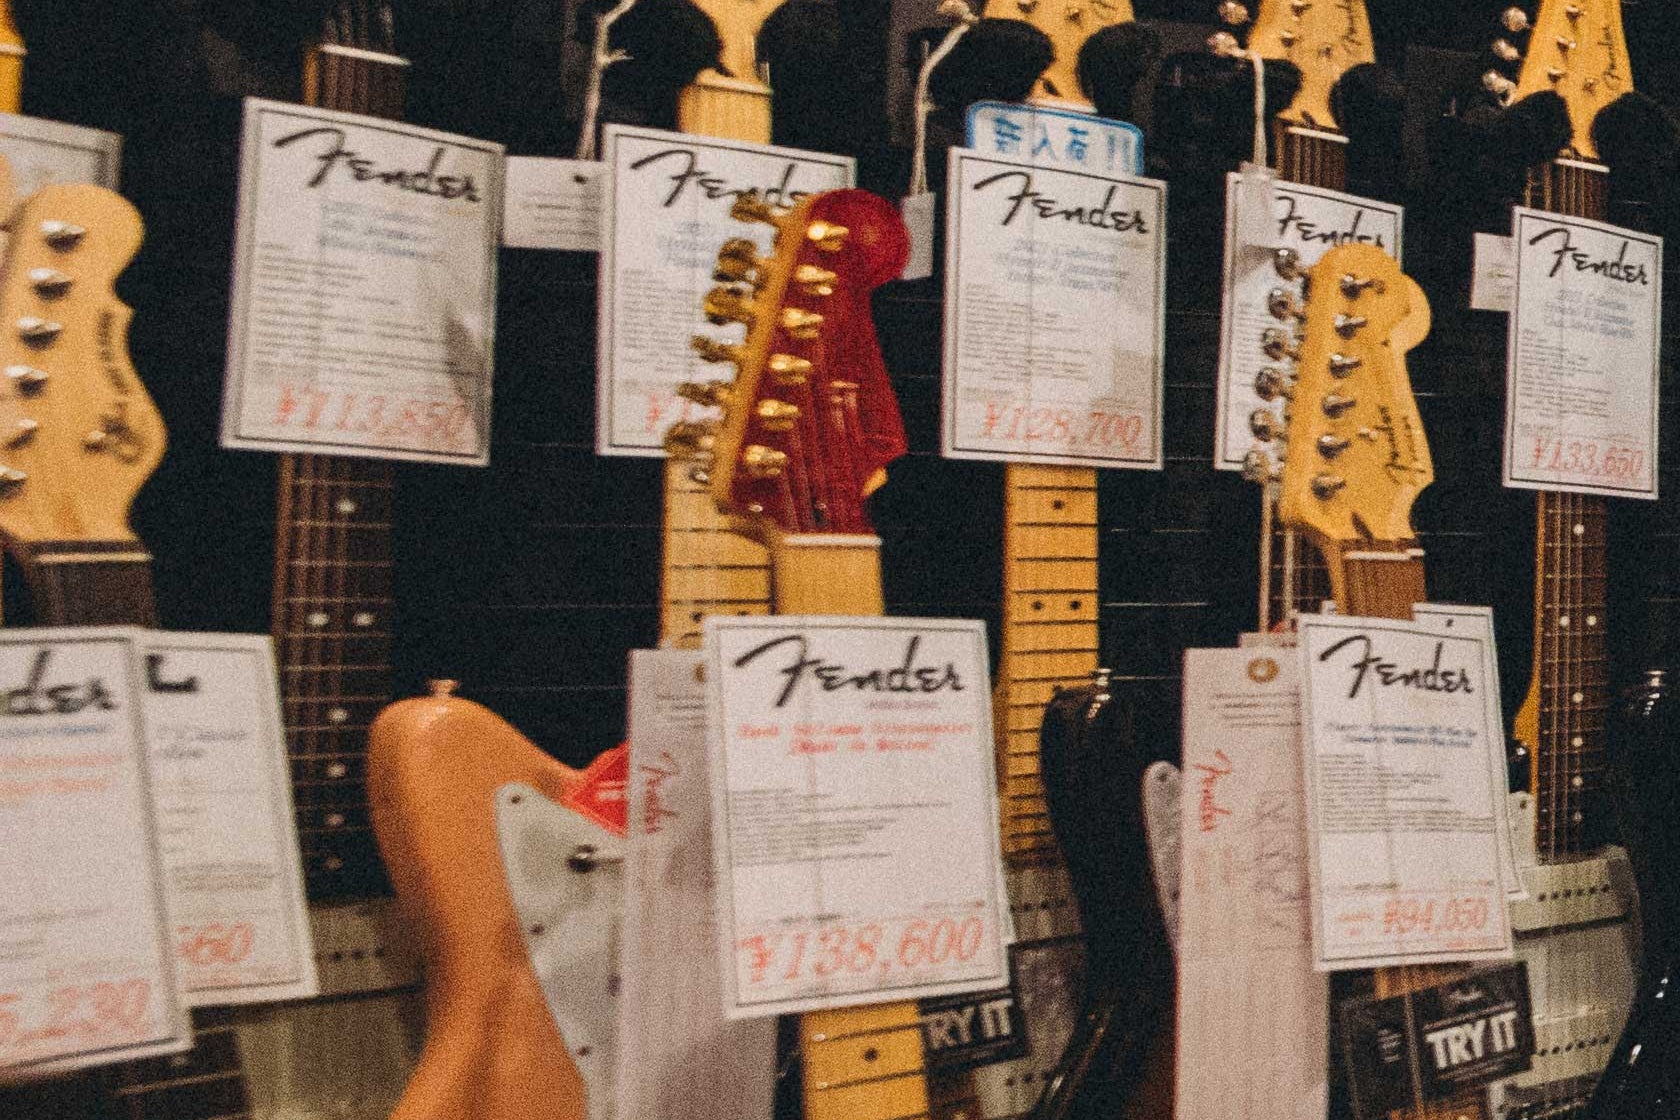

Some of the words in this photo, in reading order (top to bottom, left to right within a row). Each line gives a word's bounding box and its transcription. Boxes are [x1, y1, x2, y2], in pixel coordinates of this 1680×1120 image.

[274, 127, 483, 202] Fender
[973, 171, 1149, 235] Fender
[1529, 228, 1648, 286] Fender
[734, 635, 965, 707] Fender
[1320, 635, 1474, 698] Fender
[738, 915, 986, 983] ¥138,600
[925, 1003, 977, 1050] RY
[980, 997, 1012, 1040] IT
[1424, 1023, 1484, 1072] TRY
[1485, 1011, 1521, 1056] IT
